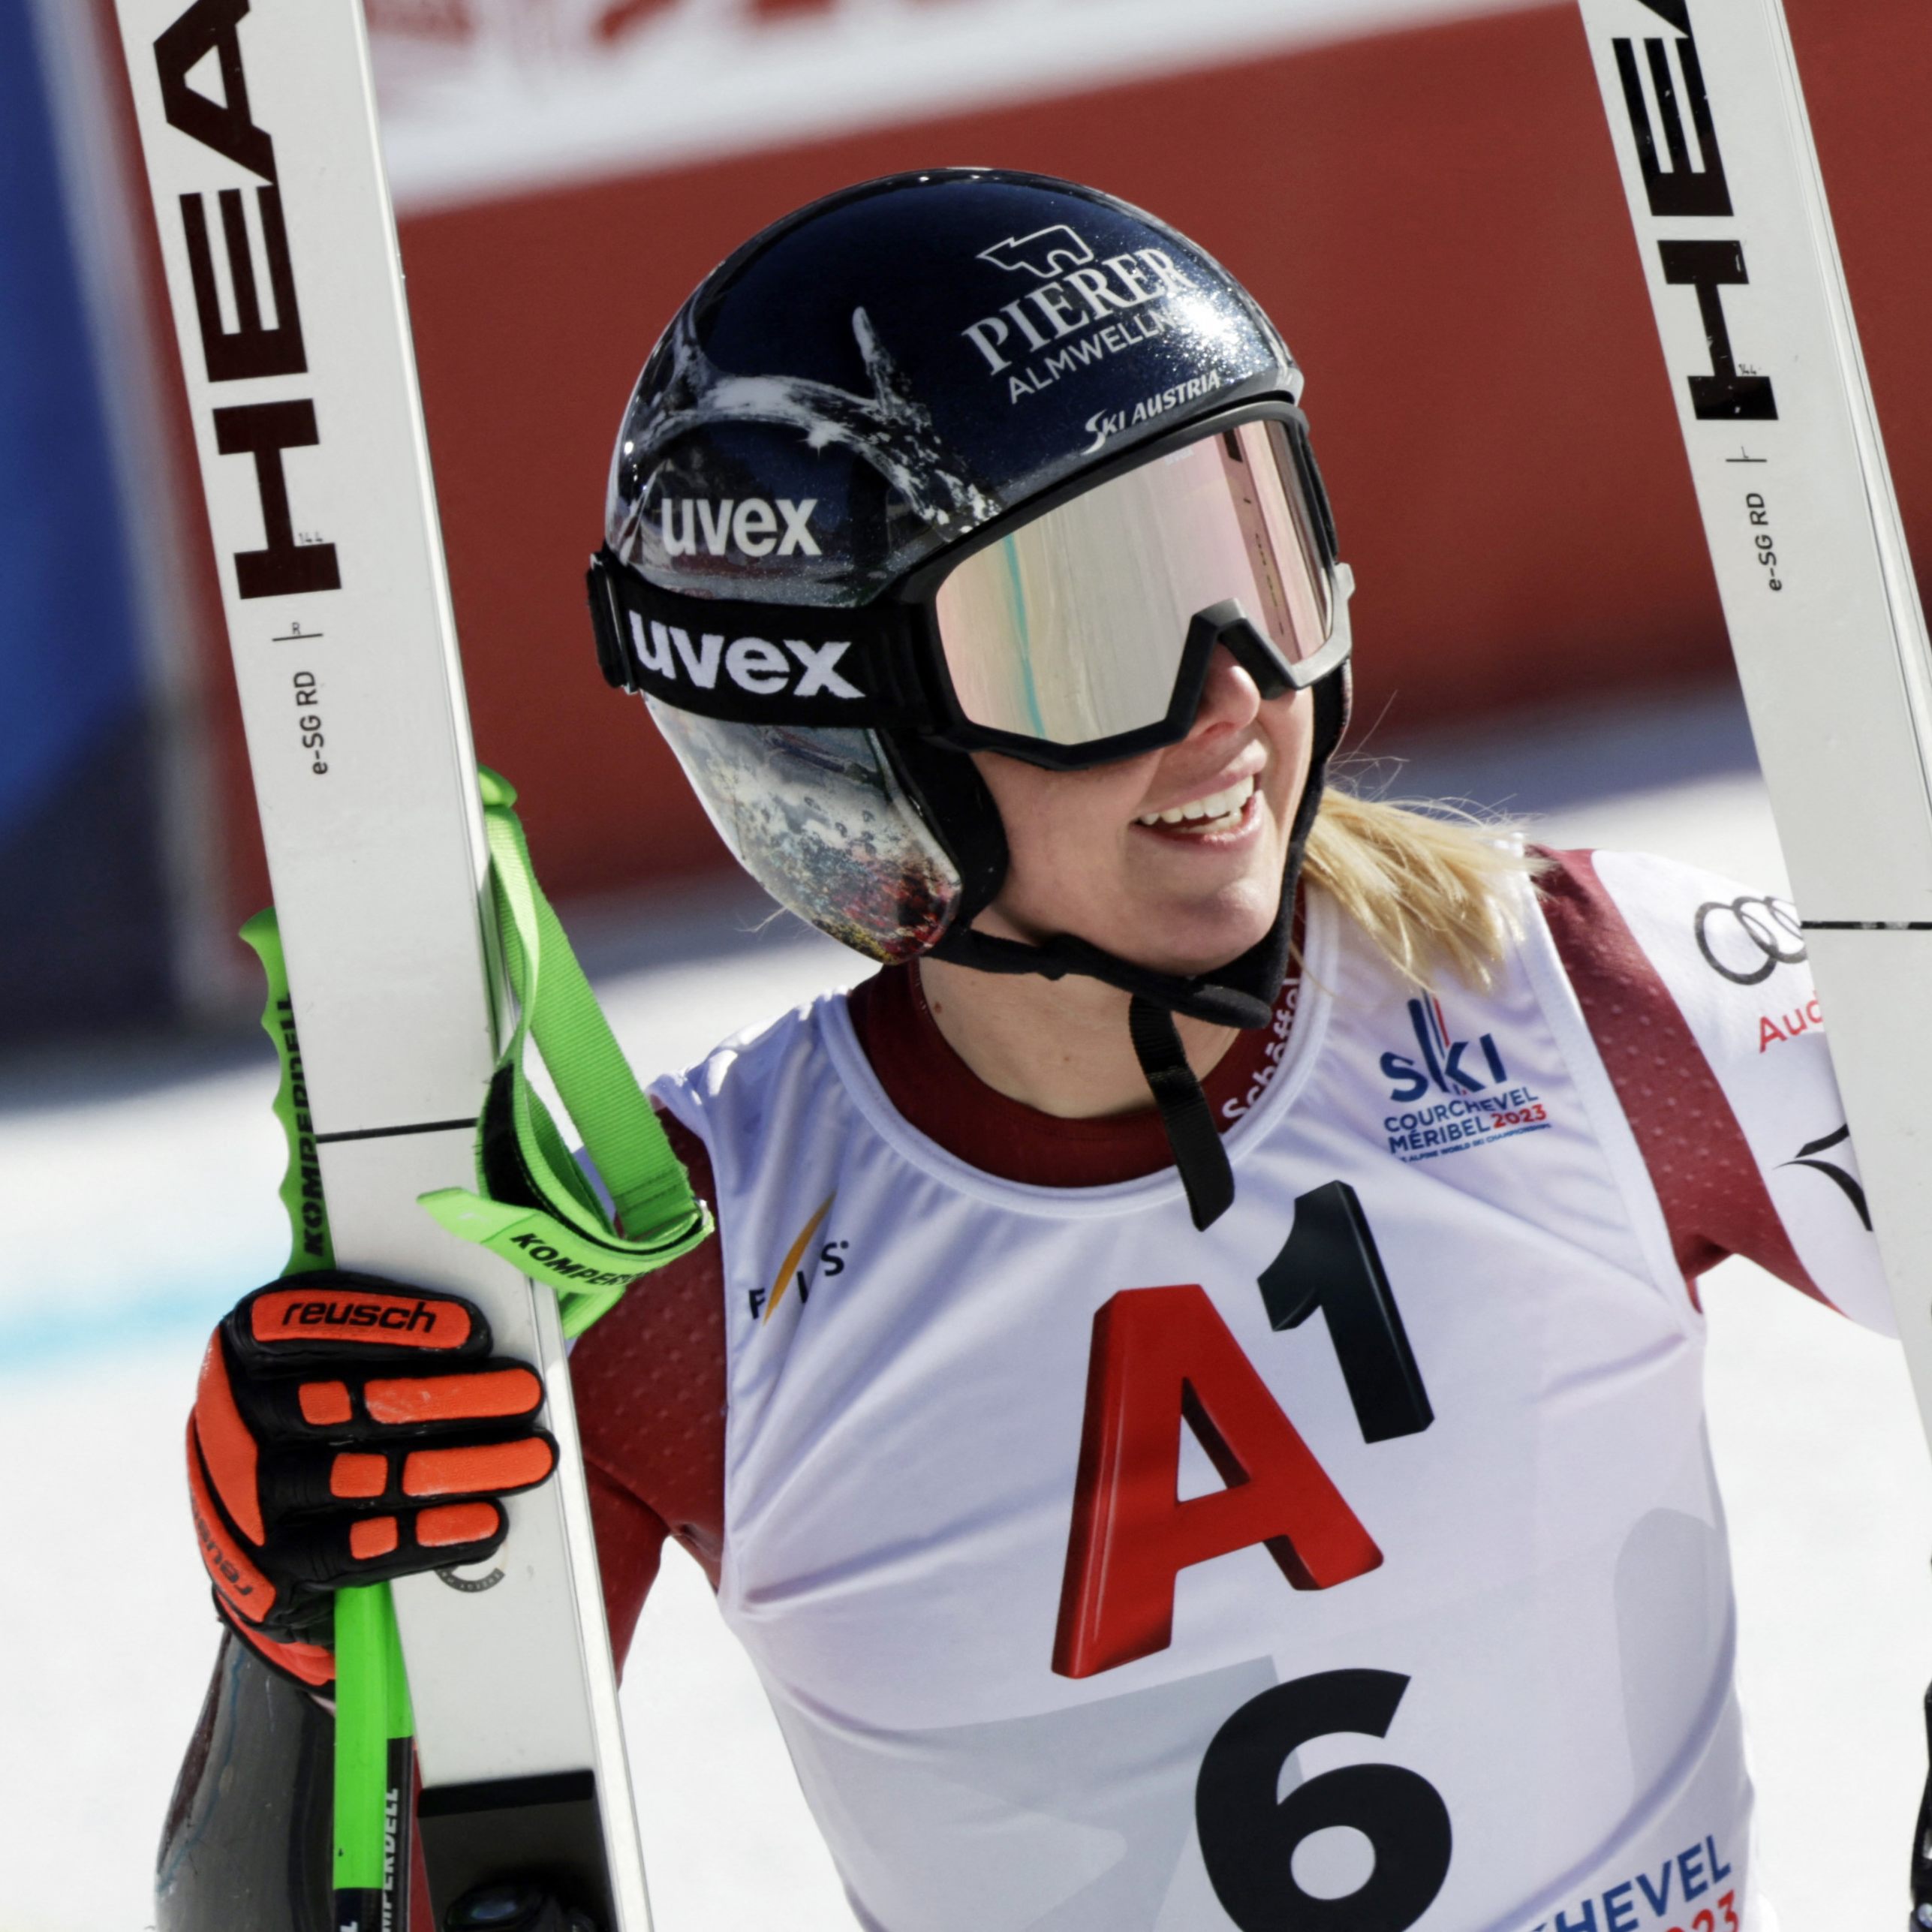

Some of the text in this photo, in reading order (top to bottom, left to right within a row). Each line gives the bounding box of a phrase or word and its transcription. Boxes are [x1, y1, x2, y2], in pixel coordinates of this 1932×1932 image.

[1612, 0, 1778, 420] HE
[961, 247, 1199, 375] PIERER
[1008, 300, 1193, 404] ALMWELLN
[1132, 369, 1220, 425] AUSTRIA
[661, 498, 822, 556] uvex
[1746, 492, 1782, 591] e-SG RD
[628, 609, 865, 699] uvex
[293, 671, 328, 775] e-SG RD
[1759, 990, 1825, 1053] Aud
[1384, 1087, 1538, 1132] COURCHEVEL
[1389, 1103, 1547, 1154] MÉRIBEL 2023
[282, 1302, 438, 1334] reusch
[1195, 1668, 1453, 1932] 6
[1532, 1834, 1731, 1932] HEVEL
